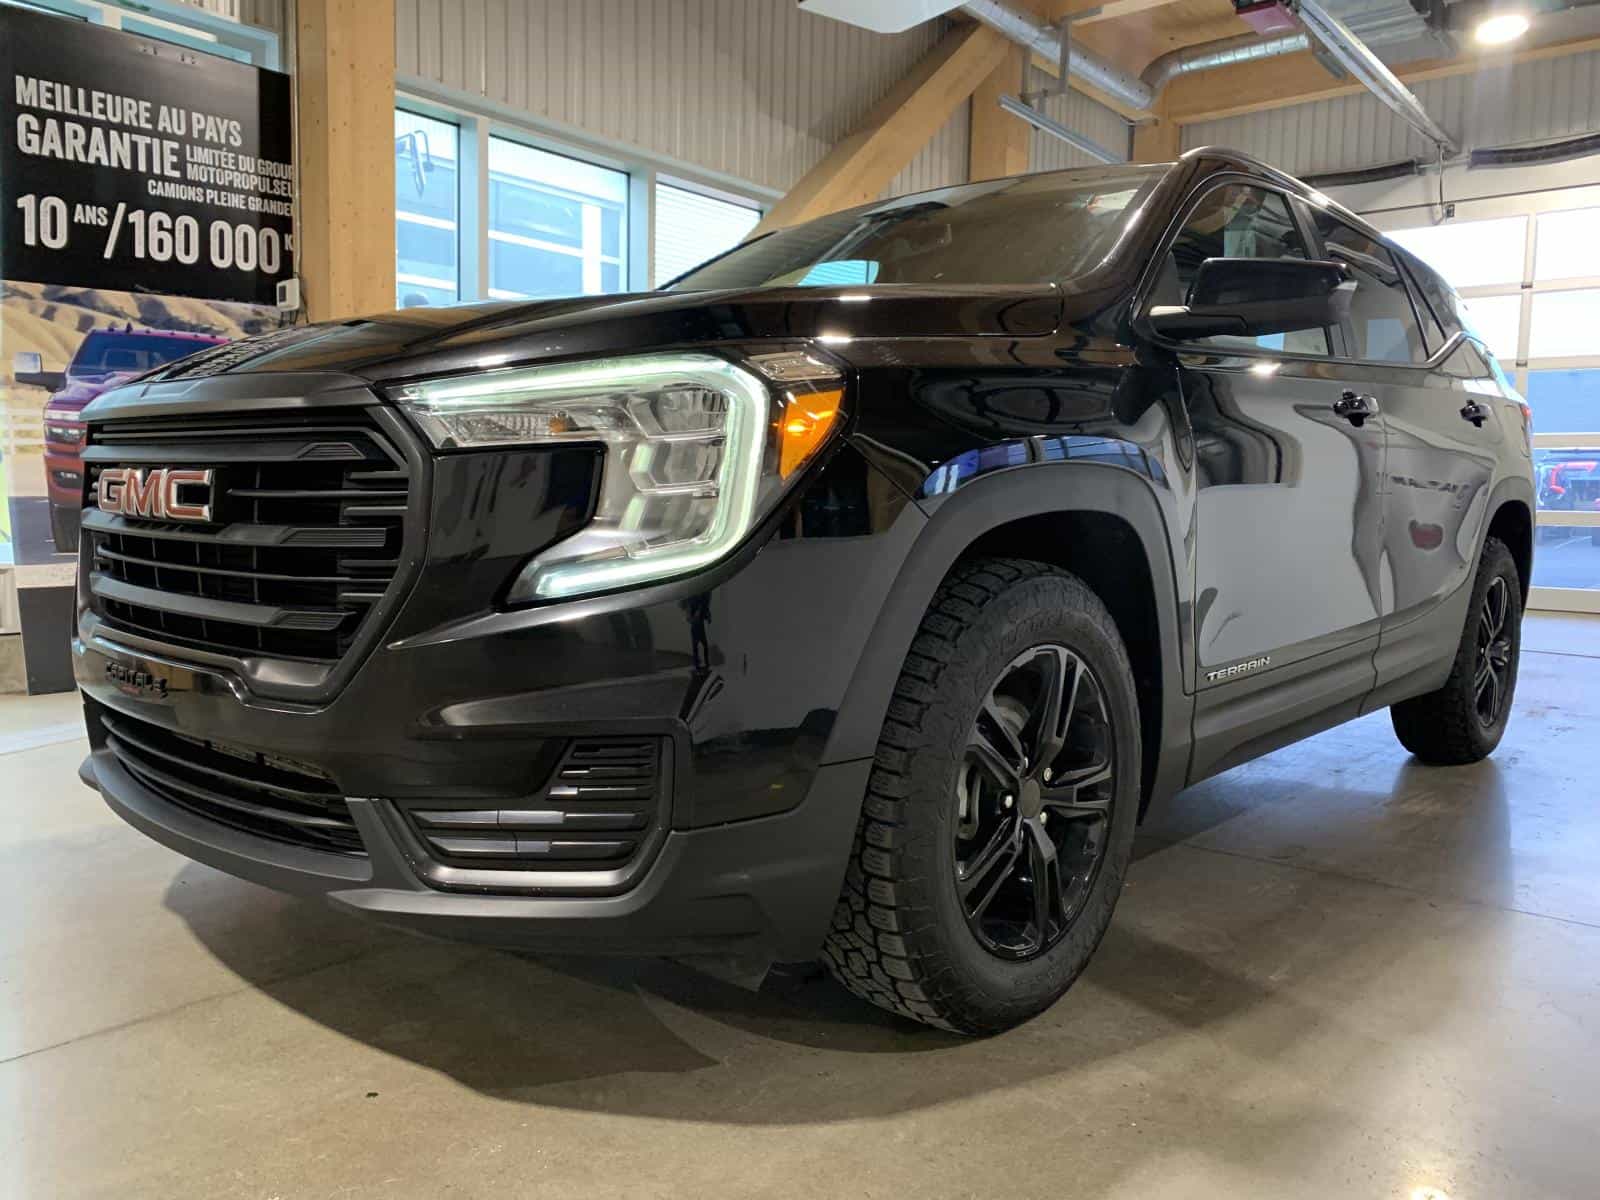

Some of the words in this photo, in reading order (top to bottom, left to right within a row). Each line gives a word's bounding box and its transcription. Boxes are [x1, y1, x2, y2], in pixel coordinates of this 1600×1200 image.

[16, 75, 152, 129] MEILLEURE
[158, 105, 186, 136] AU
[192, 112, 241, 146] PAYS
[17, 113, 180, 178] GARANTIE
[186, 144, 236, 170] LIMITÉE
[238, 155, 255, 173] DU
[148, 180, 204, 203] CAMIONS
[206, 189, 247, 210] PLEINE
[248, 196, 292, 216] GRANDE
[17, 194, 68, 249] 10
[210, 220, 280, 274] 000
[98, 468, 214, 521] GMC
[1207, 656, 1271, 681] TERRAIN
